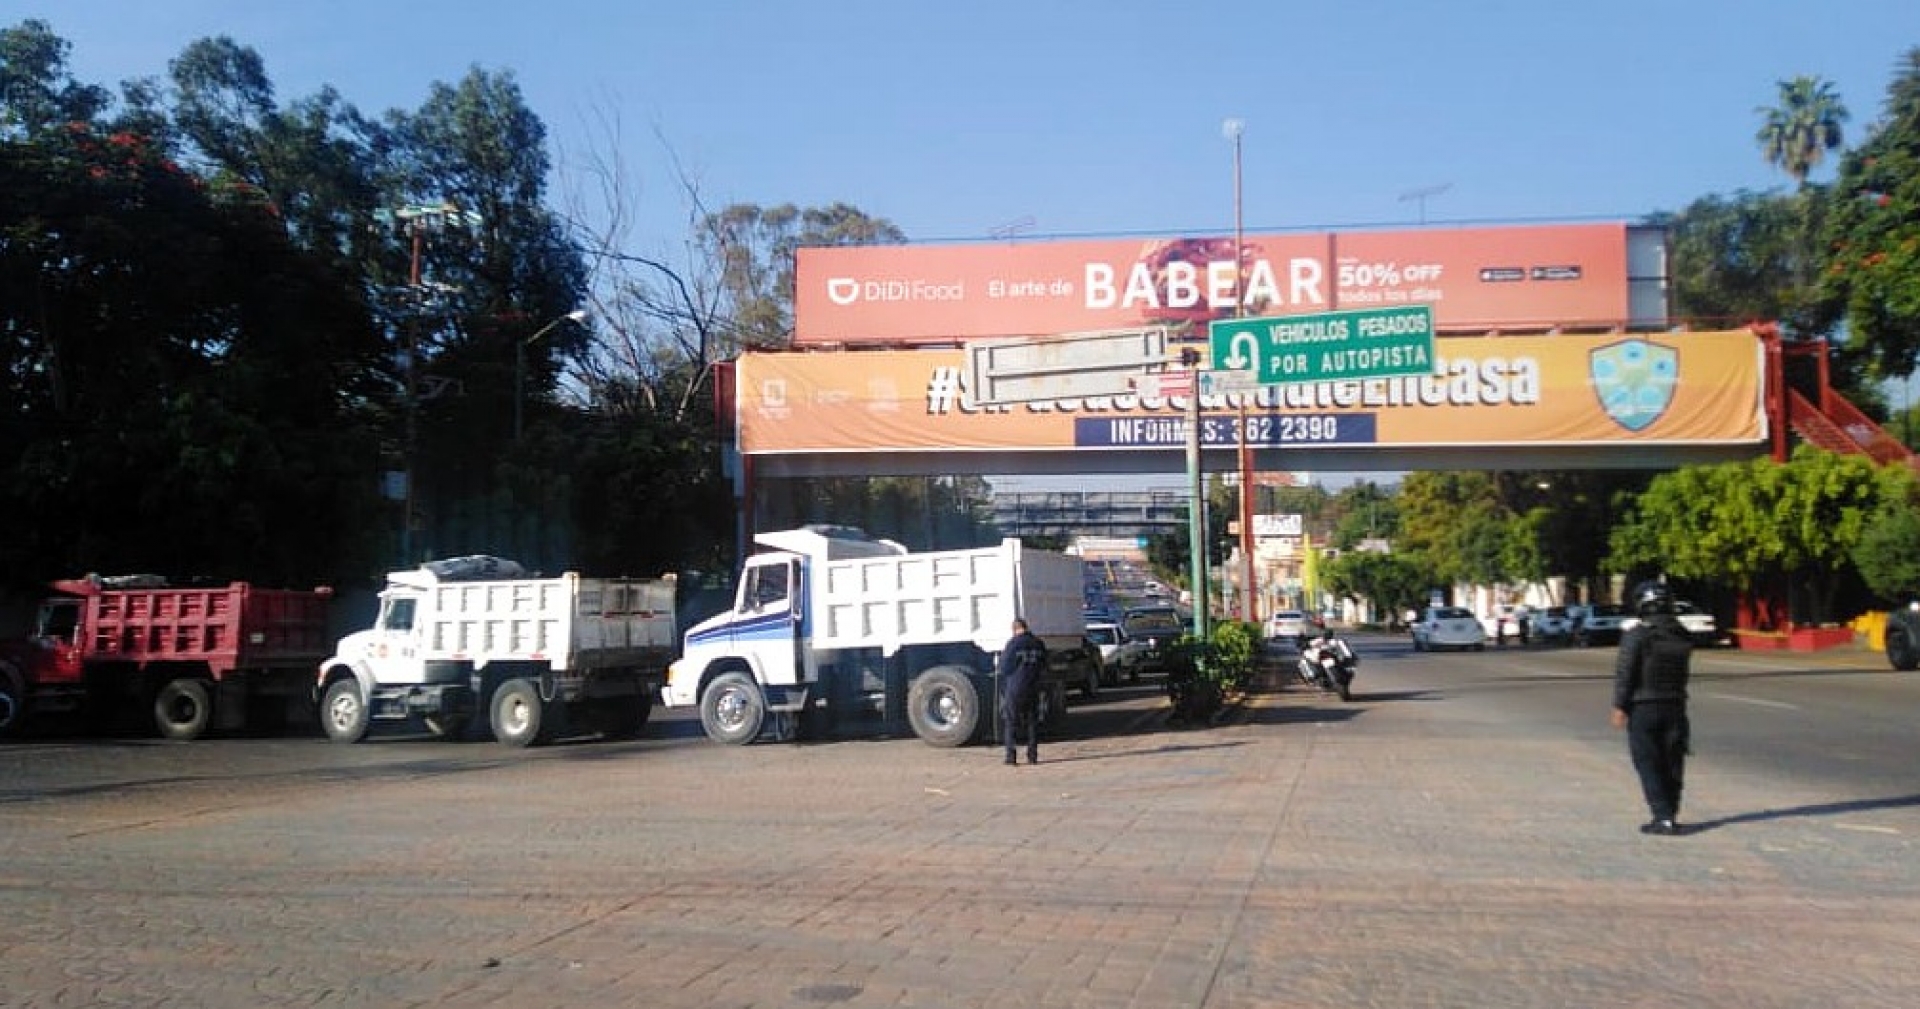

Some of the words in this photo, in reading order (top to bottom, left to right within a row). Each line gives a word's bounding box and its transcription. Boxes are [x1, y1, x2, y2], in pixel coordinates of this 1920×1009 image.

[988, 279, 1005, 297] El
[1010, 281, 1045, 297] arte
[1050, 278, 1074, 296] de
[1084, 257, 1323, 309] BABEAR
[1337, 262, 1400, 287] 50%
[1403, 264, 1444, 282] OFF
[865, 279, 910, 300] DiDi
[912, 279, 964, 300] Food
[1268, 319, 1349, 345] VEHICULOS
[1357, 312, 1427, 338] PESADOS
[1271, 353, 1309, 375] POR
[1320, 344, 1428, 374] AUTOPISTA
[1110, 417, 1225, 443] INFORMS:
[1280, 415, 1338, 441] 2390
